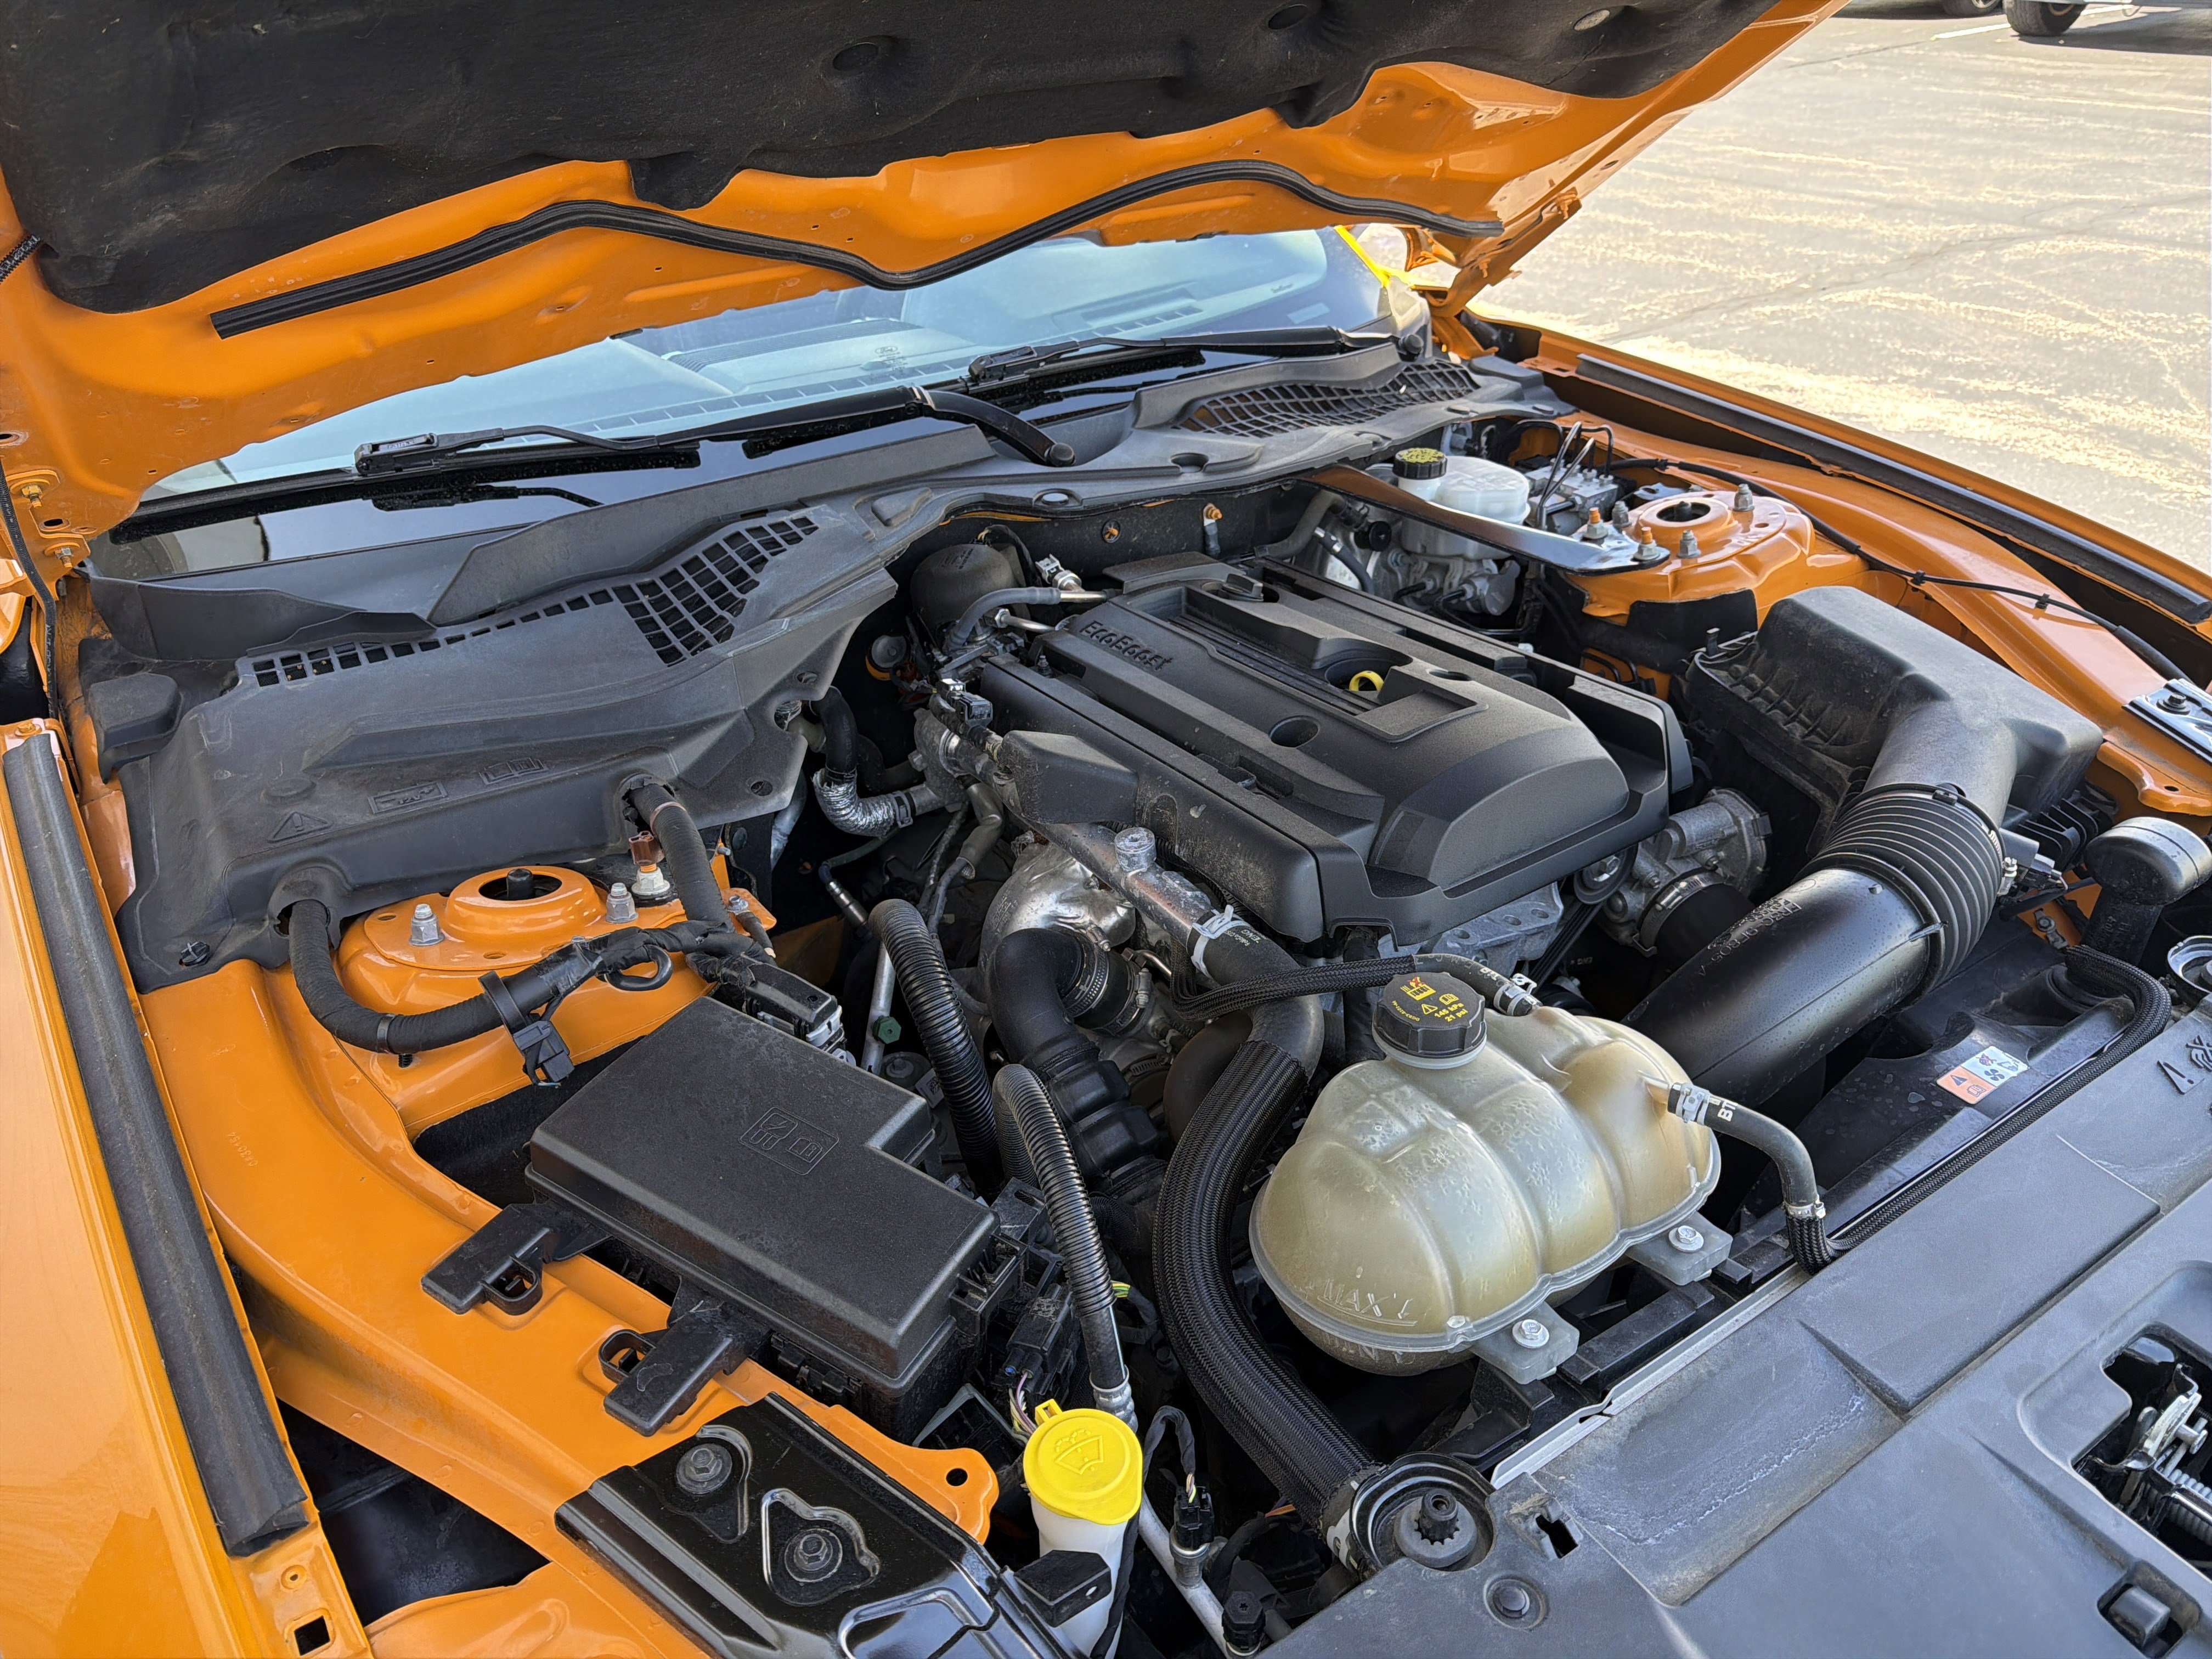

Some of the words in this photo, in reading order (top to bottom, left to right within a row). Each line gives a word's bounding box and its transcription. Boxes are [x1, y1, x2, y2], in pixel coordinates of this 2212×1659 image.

[1435, 1008, 1449, 1018] 145
[1448, 1002, 1464, 1012] kPa
[1455, 1008, 1469, 1018] psi
